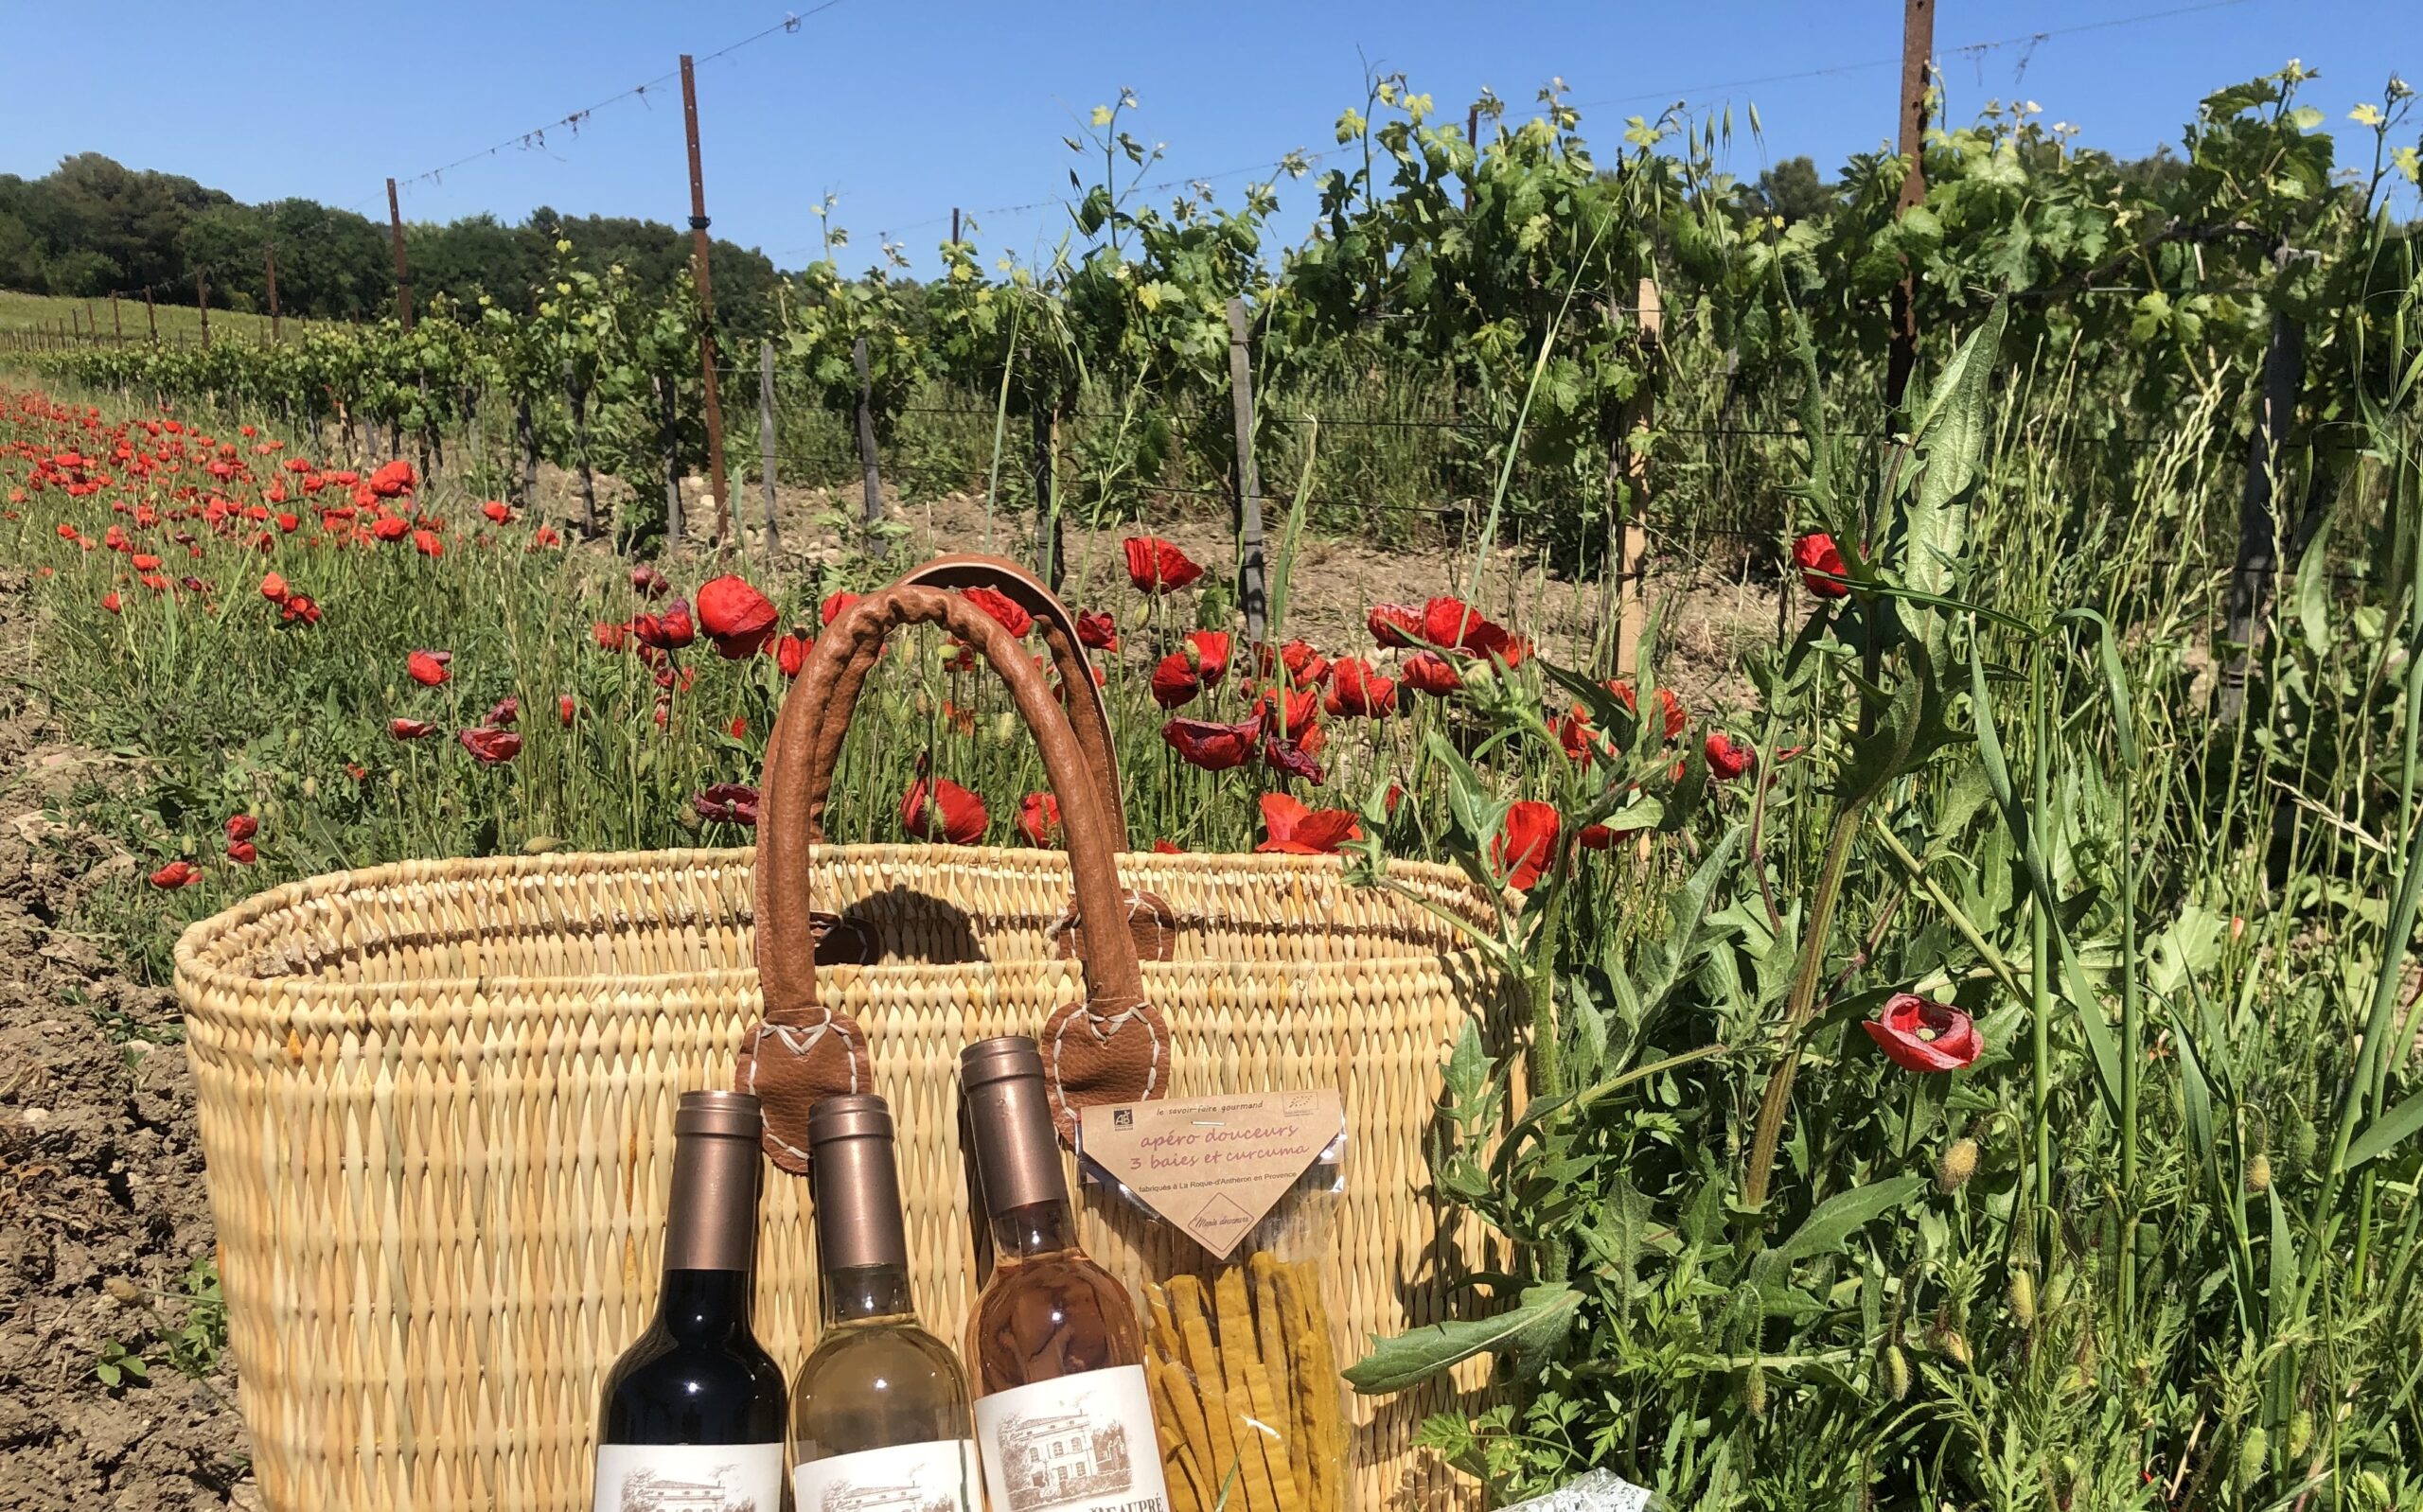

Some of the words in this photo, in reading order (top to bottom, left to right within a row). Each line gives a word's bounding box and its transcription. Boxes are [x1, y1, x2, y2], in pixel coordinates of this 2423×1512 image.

[1157, 1107, 1164, 1116] le
[1168, 1105, 1217, 1115] savoir-faire
[1221, 1099, 1264, 1114] gourmand
[1140, 1130, 1200, 1152] apéro
[1204, 1124, 1300, 1143] douceurs
[1130, 1157, 1142, 1169] 3
[1150, 1152, 1201, 1169] baies
[1203, 1151, 1222, 1165] et
[1226, 1145, 1310, 1163] curcuma
[1179, 1182, 1189, 1190] La
[1264, 1170, 1298, 1180] Provence
